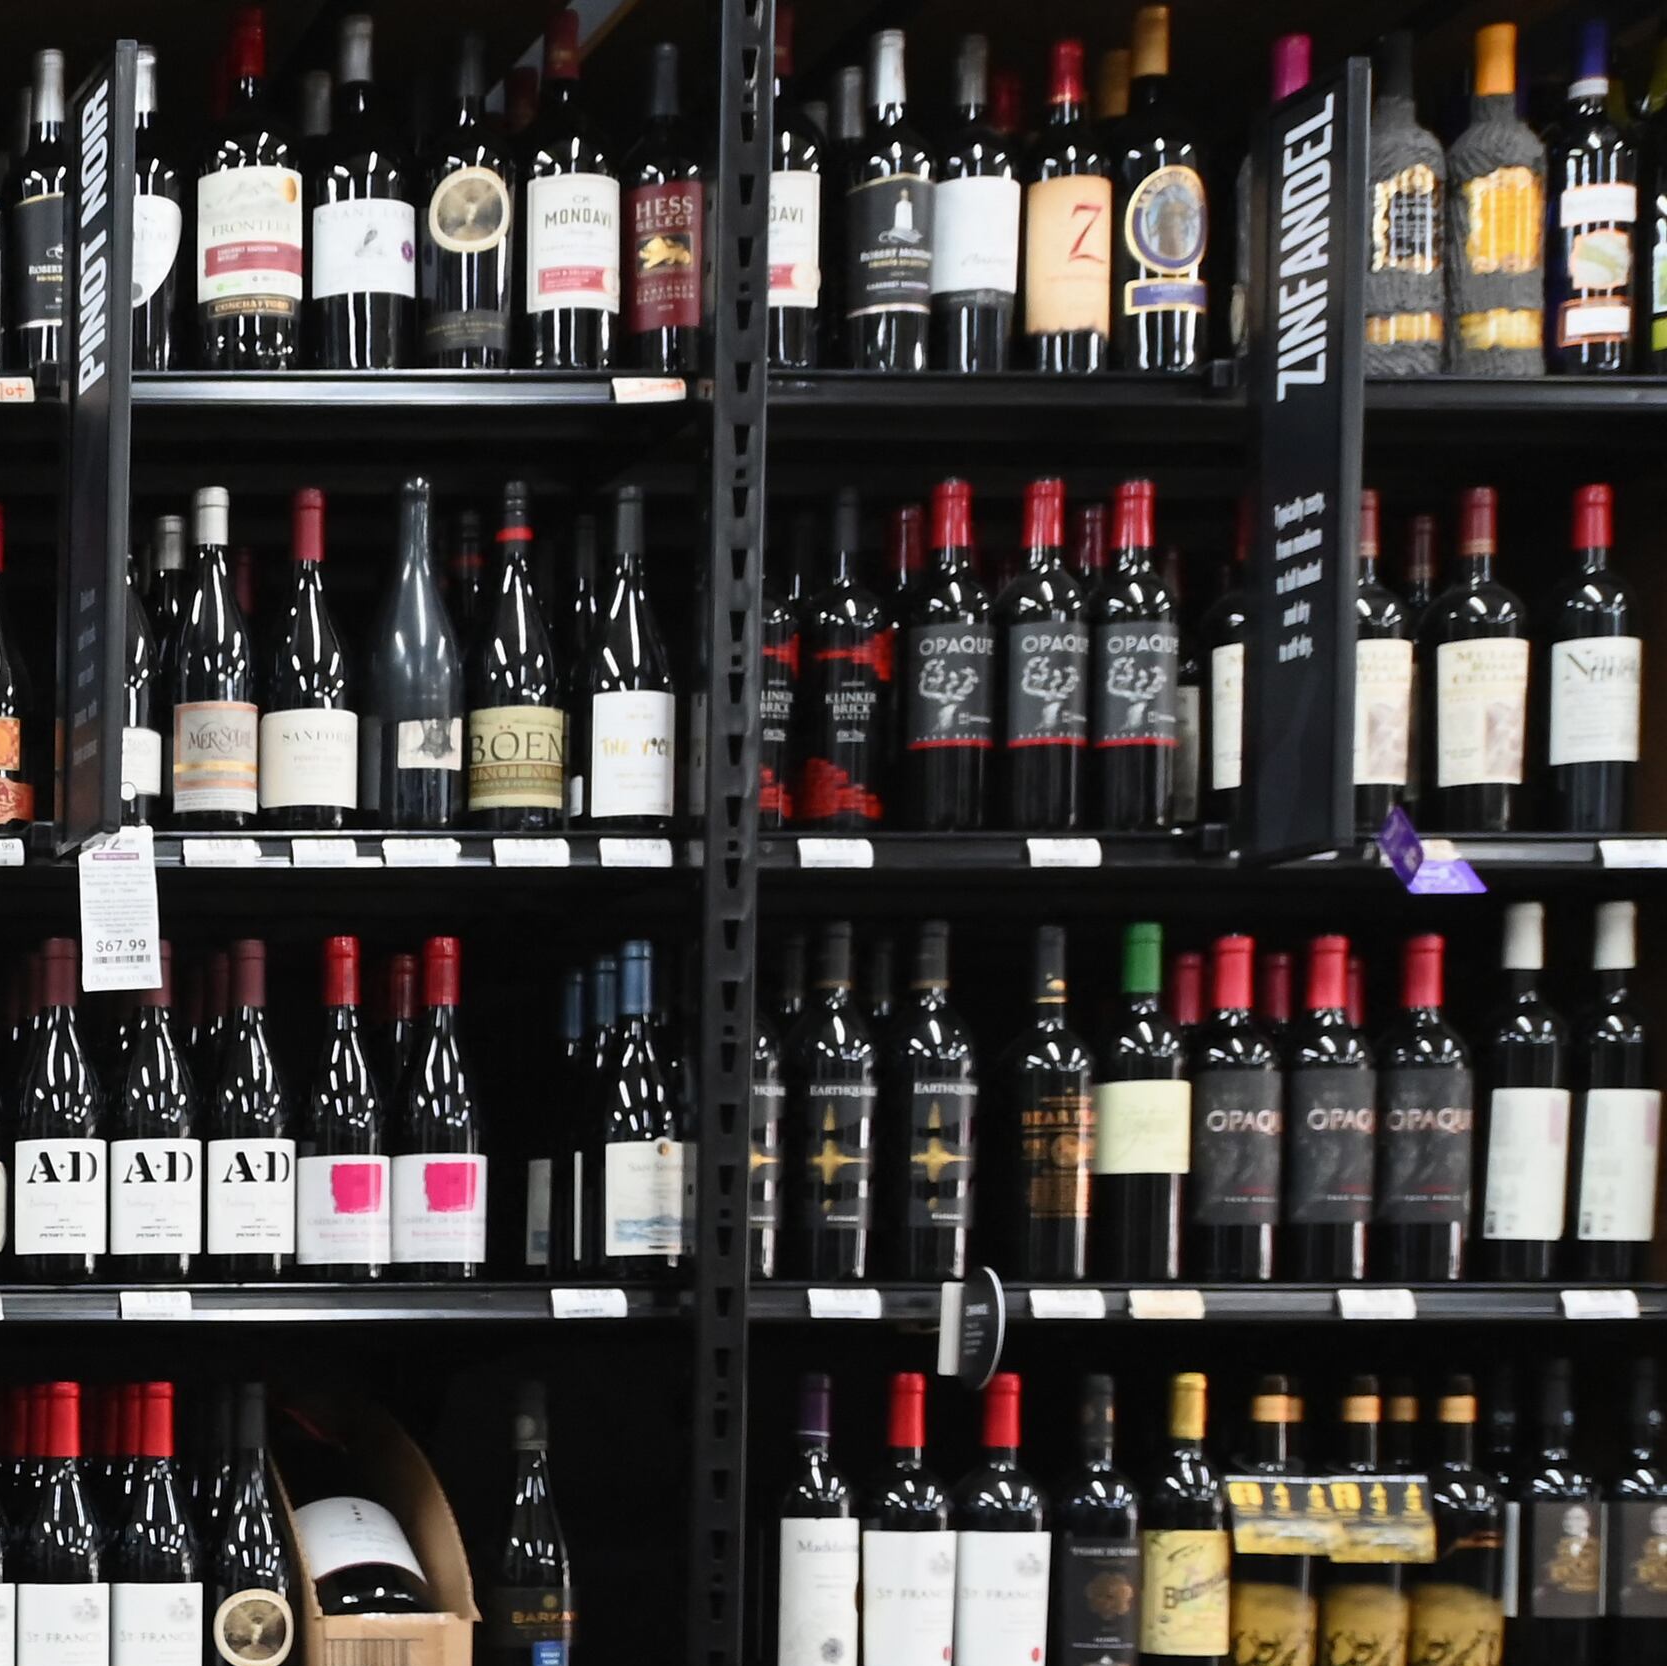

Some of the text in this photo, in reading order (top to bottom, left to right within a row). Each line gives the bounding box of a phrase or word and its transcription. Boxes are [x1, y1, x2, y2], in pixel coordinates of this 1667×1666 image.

[544, 206, 611, 228] MONDAVI
[634, 197, 694, 218] HESS
[636, 216, 692, 231] SELECT
[78, 80, 108, 395] PINOT NOIR
[1068, 204, 1106, 264] Z
[1276, 92, 1334, 402] ZINFANDEL
[919, 637, 994, 656] OPAQUE
[1021, 634, 1089, 653] OPAQUE
[1108, 634, 1179, 655] OPAQUE
[825, 693, 877, 704] KLINKER
[833, 703, 870, 715] BRICK
[281, 729, 353, 742] SANFORD
[470, 722, 564, 763] BÖEN
[95, 939, 147, 953] $67.99
[809, 1085, 877, 1097] EARTHQUAKE
[914, 1083, 978, 1095] EARTHQUAKE
[1307, 1108, 1375, 1132] OPAQ
